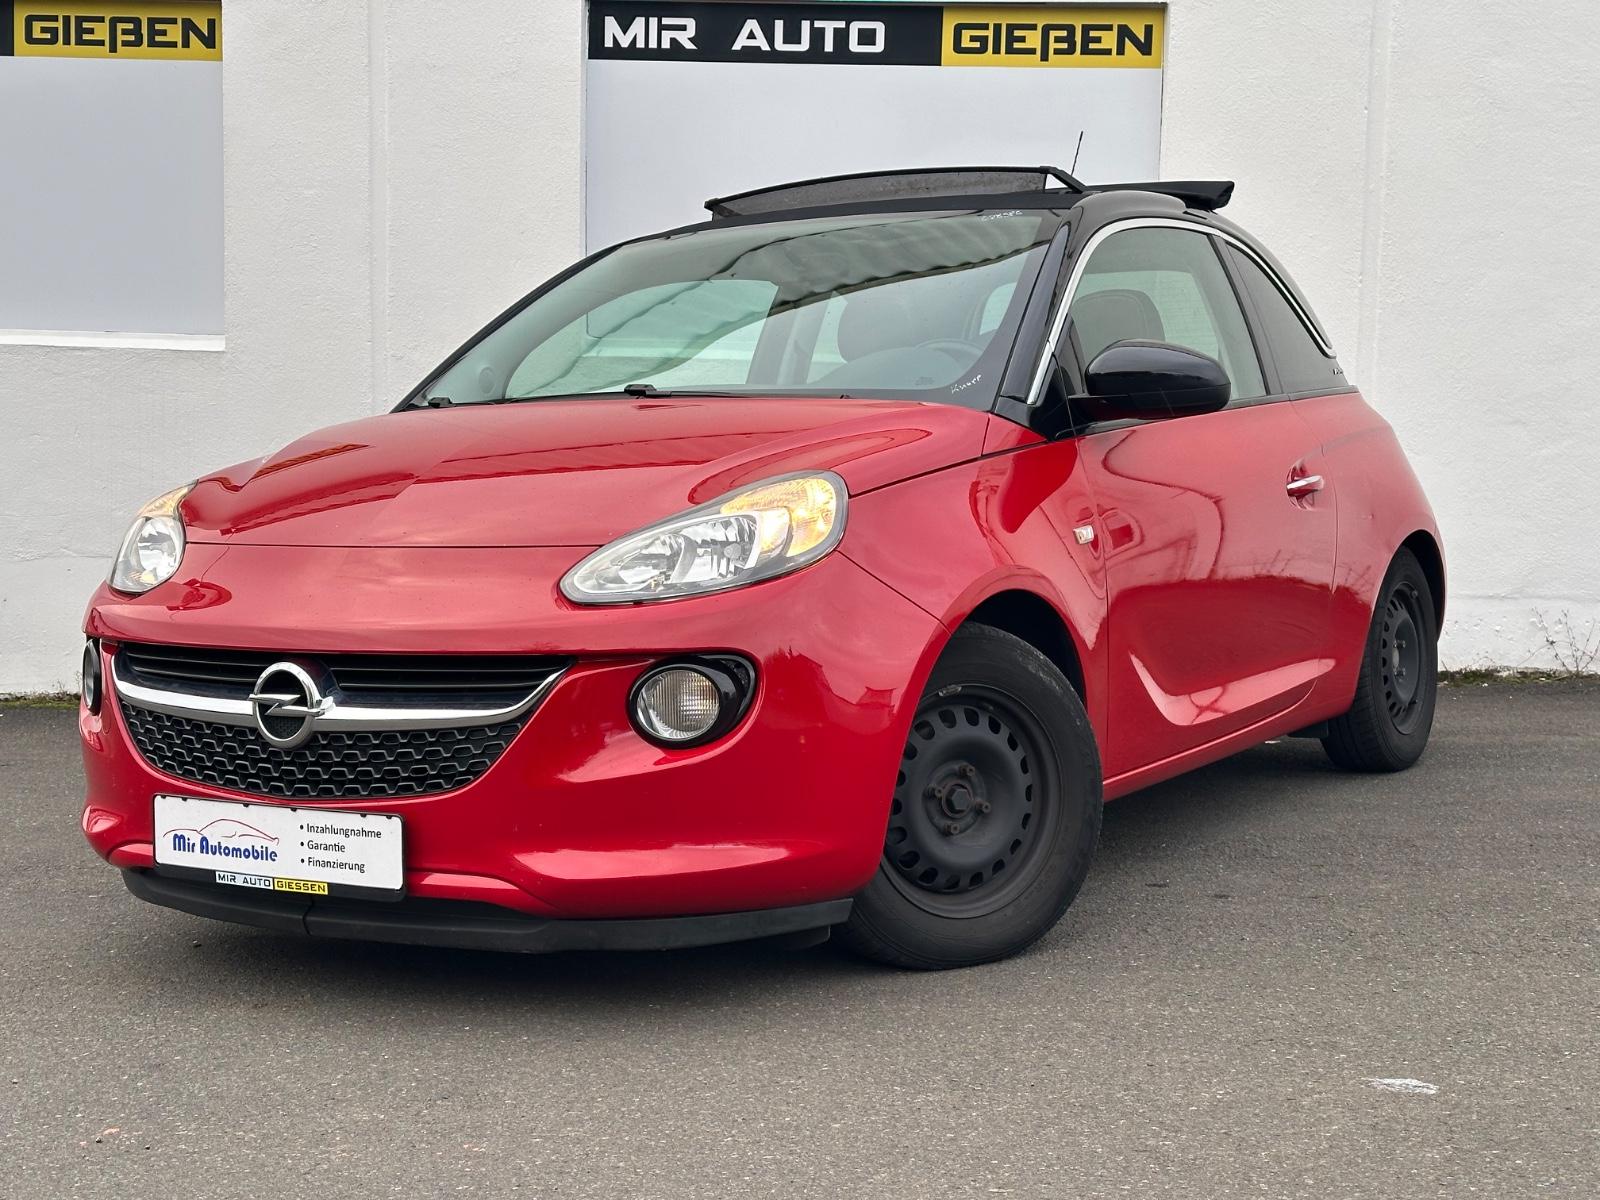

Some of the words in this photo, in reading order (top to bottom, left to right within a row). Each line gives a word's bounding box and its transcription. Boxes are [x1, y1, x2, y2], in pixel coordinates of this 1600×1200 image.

[604, 16, 698, 50] MIR
[731, 18, 886, 53] AUTO
[306, 823, 382, 839] Inzahlungnahme
[172, 833, 196, 853] Mir
[199, 835, 278, 862] Automobile
[307, 840, 346, 853] Garantie
[307, 856, 366, 874] Finanzierung
[217, 873, 237, 883] MIR
[242, 876, 271, 888] AUTO
[276, 880, 326, 893] GIESSEN
